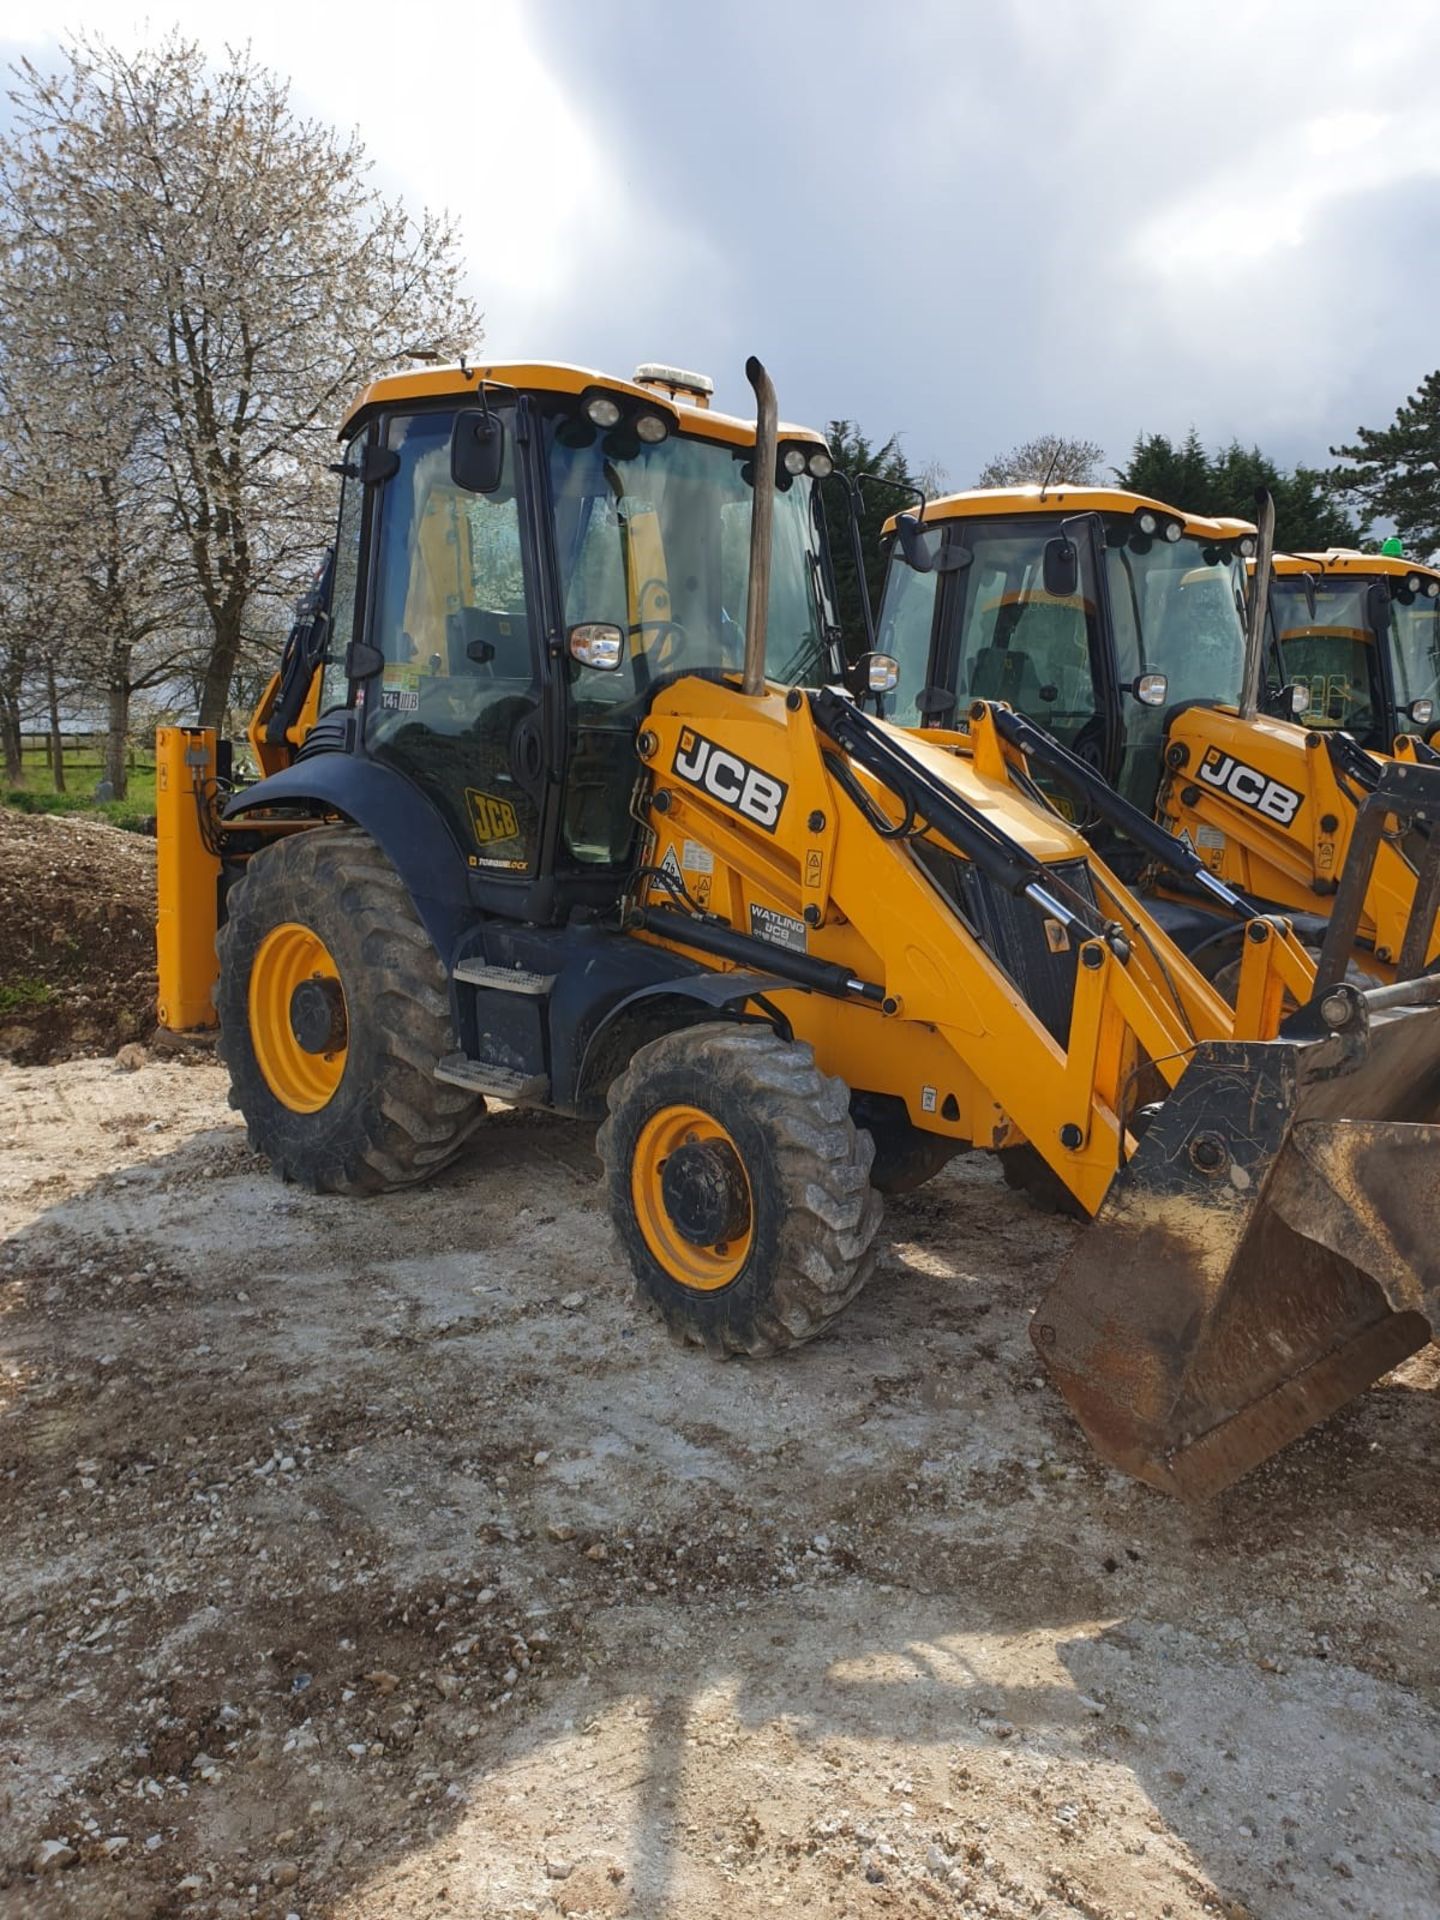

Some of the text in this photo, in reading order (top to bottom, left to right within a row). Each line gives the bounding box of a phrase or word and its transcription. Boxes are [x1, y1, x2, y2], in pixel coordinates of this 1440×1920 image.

[676, 740, 782, 826] JCB
[1201, 757, 1299, 823] JCB
[474, 794, 517, 840] JCB
[751, 904, 805, 934] WATLING
[765, 922, 789, 940] JCB
